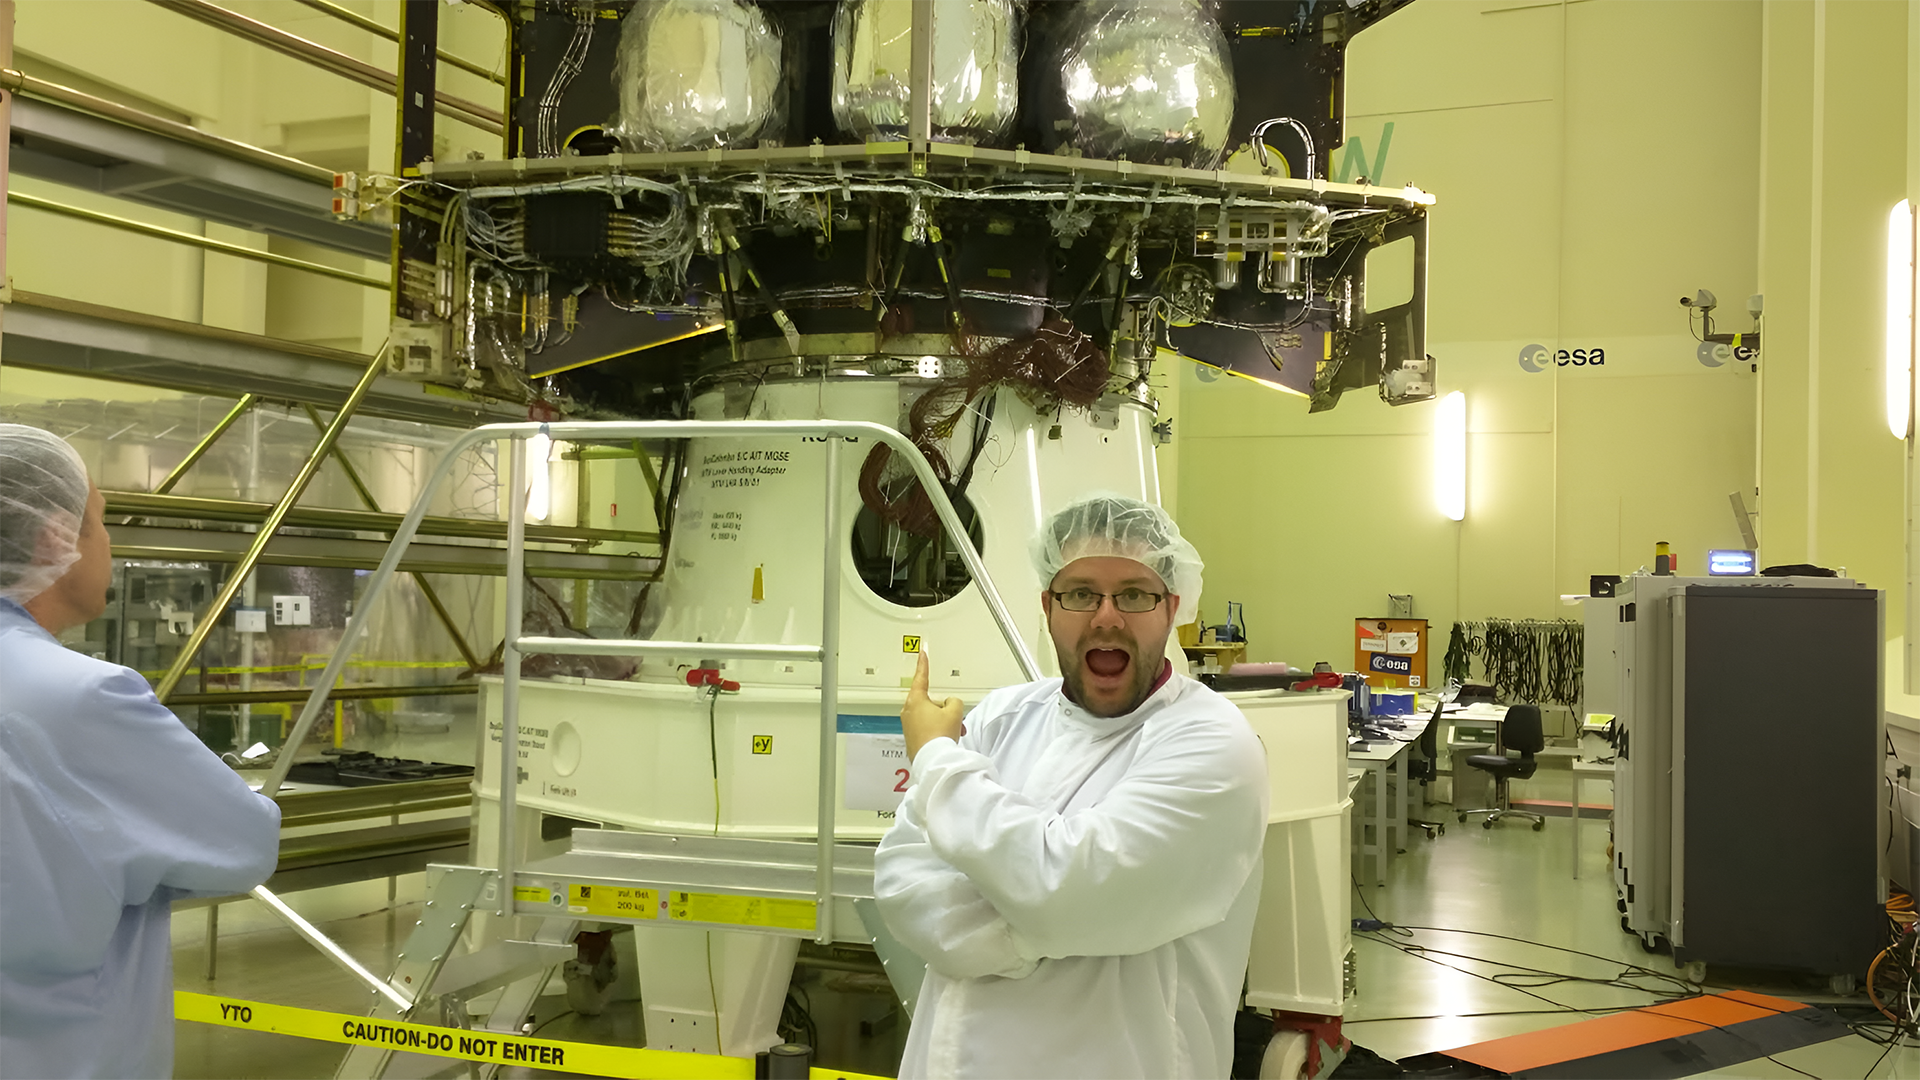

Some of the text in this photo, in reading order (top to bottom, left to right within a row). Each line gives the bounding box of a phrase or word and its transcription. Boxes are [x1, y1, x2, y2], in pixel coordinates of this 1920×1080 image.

[1553, 348, 1605, 367] esa
[220, 1003, 252, 1023] YTO
[342, 1020, 565, 1065] CAUTION-DO NOT ENTER
